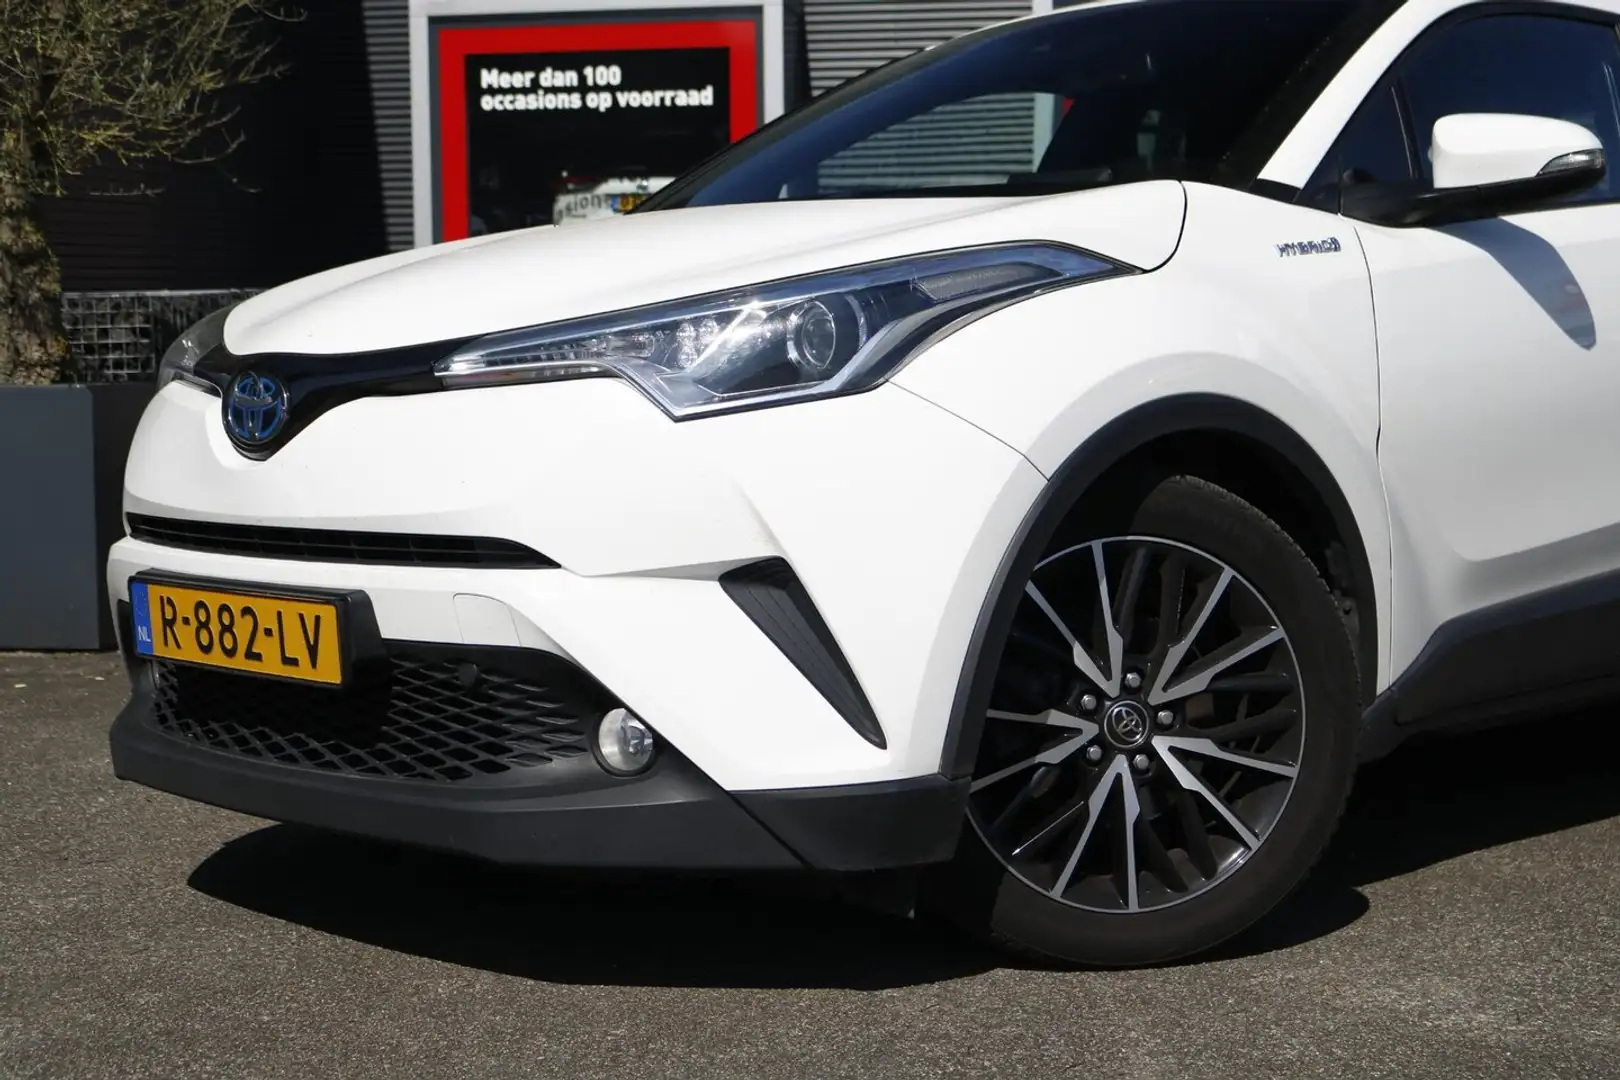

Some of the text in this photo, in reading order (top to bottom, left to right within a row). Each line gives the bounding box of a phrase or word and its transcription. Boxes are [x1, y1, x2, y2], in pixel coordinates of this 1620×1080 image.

[480, 65, 621, 88] Meer dan 100
[480, 85, 714, 112] occasions op voorraad
[1277, 237, 1338, 257] HYBRID
[138, 625, 151, 643] NL
[159, 594, 321, 669] R-882-LV
